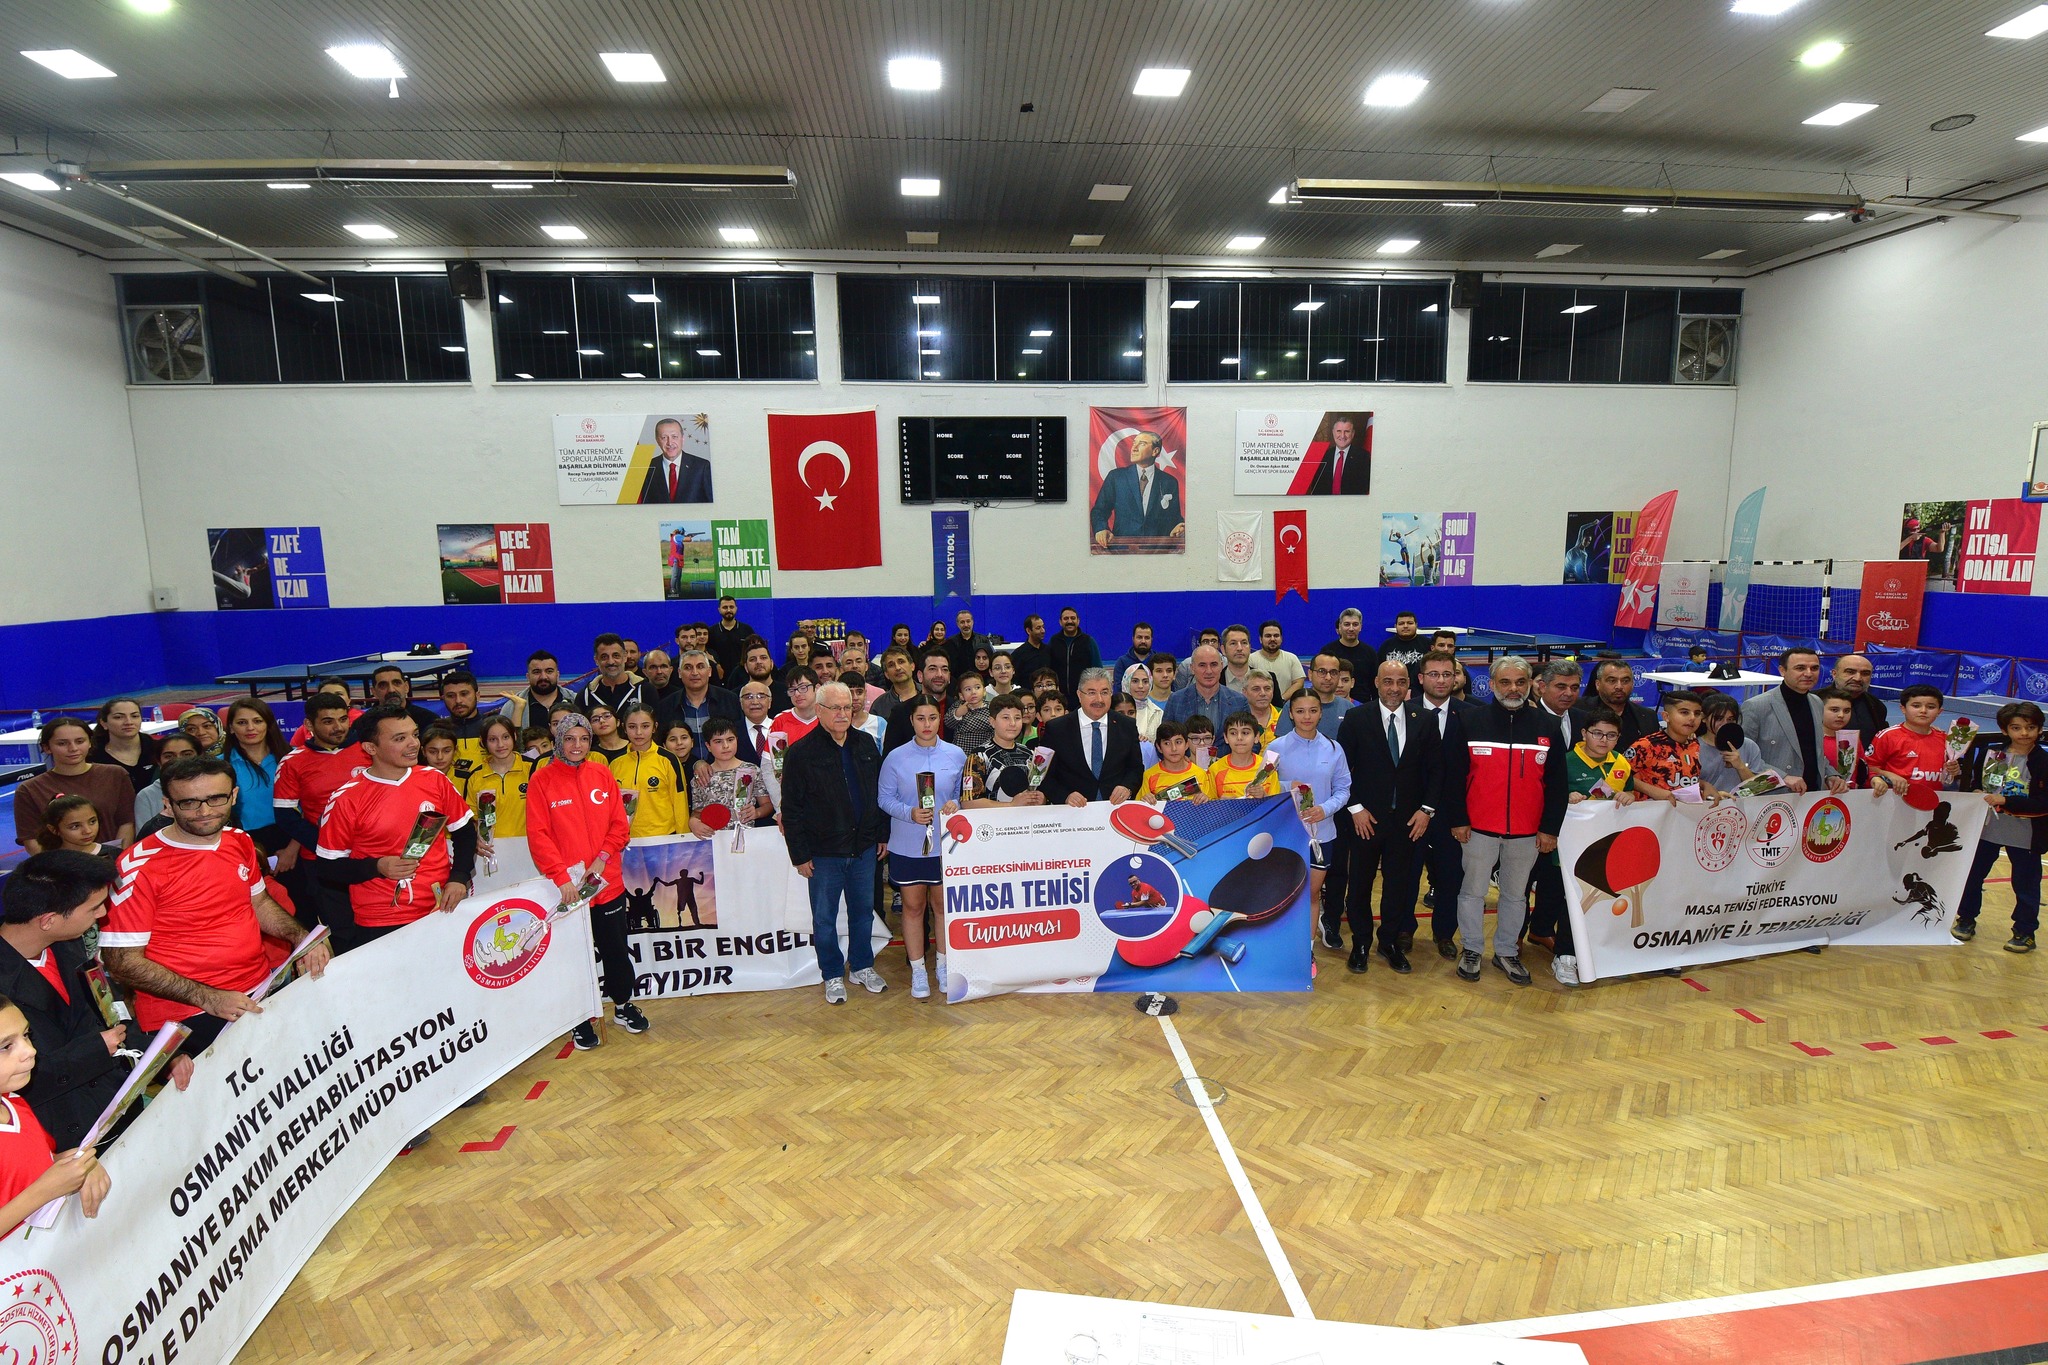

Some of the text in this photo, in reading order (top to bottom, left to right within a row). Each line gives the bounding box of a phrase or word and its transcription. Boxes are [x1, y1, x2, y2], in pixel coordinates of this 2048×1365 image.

[1969, 506, 1991, 530] İYİ
[270, 534, 302, 554] ZAFE
[499, 530, 531, 550] BECE
[716, 527, 740, 546] TAM
[1966, 534, 2008, 556] ATIŞA
[718, 548, 765, 567] İSABETE
[946, 533, 955, 579] VOLEYBOL
[1444, 539, 1456, 556] CA
[1443, 558, 1466, 578] ULAŞ
[1613, 557, 1629, 574] UZ
[1963, 559, 2034, 583] ODAKLAN
[276, 579, 309, 598] UZAN
[719, 569, 771, 588] ODAKLAN
[16, 772, 35, 781] STIGA
[1667, 772, 1699, 788] Jee
[1910, 767, 1943, 782] bwi
[1761, 847, 1781, 857] TMTF
[945, 858, 1091, 877] ÖZEL GEREKSİNİMLİ BİREYLER
[946, 871, 1090, 914] MASA TENİSİ
[1746, 879, 1786, 896] TÜRKİYE
[1685, 893, 1838, 916] MASA TENİSİ FEDERASYONU
[963, 919, 1061, 944] Turnuvası
[1633, 910, 1871, 949] OSMANİYE İL TEMSİLCİLİĞİ
[653, 935, 705, 962] BİR
[476, 943, 548, 987] OSMANİYE VALİLİĞİ
[225, 1057, 265, 1098] T.C.
[170, 1024, 354, 1218] OSMANİYE VALİLİĞİ
[102, 1007, 456, 1365] OSMANİYE BAKIM REHABİLİTASYON
[179, 1018, 488, 1343] DANIŞMA MERKEZİ MÜDÜRLÜĞÜ
[0, 1307, 56, 1348] SOSYAL HİZMETLER
